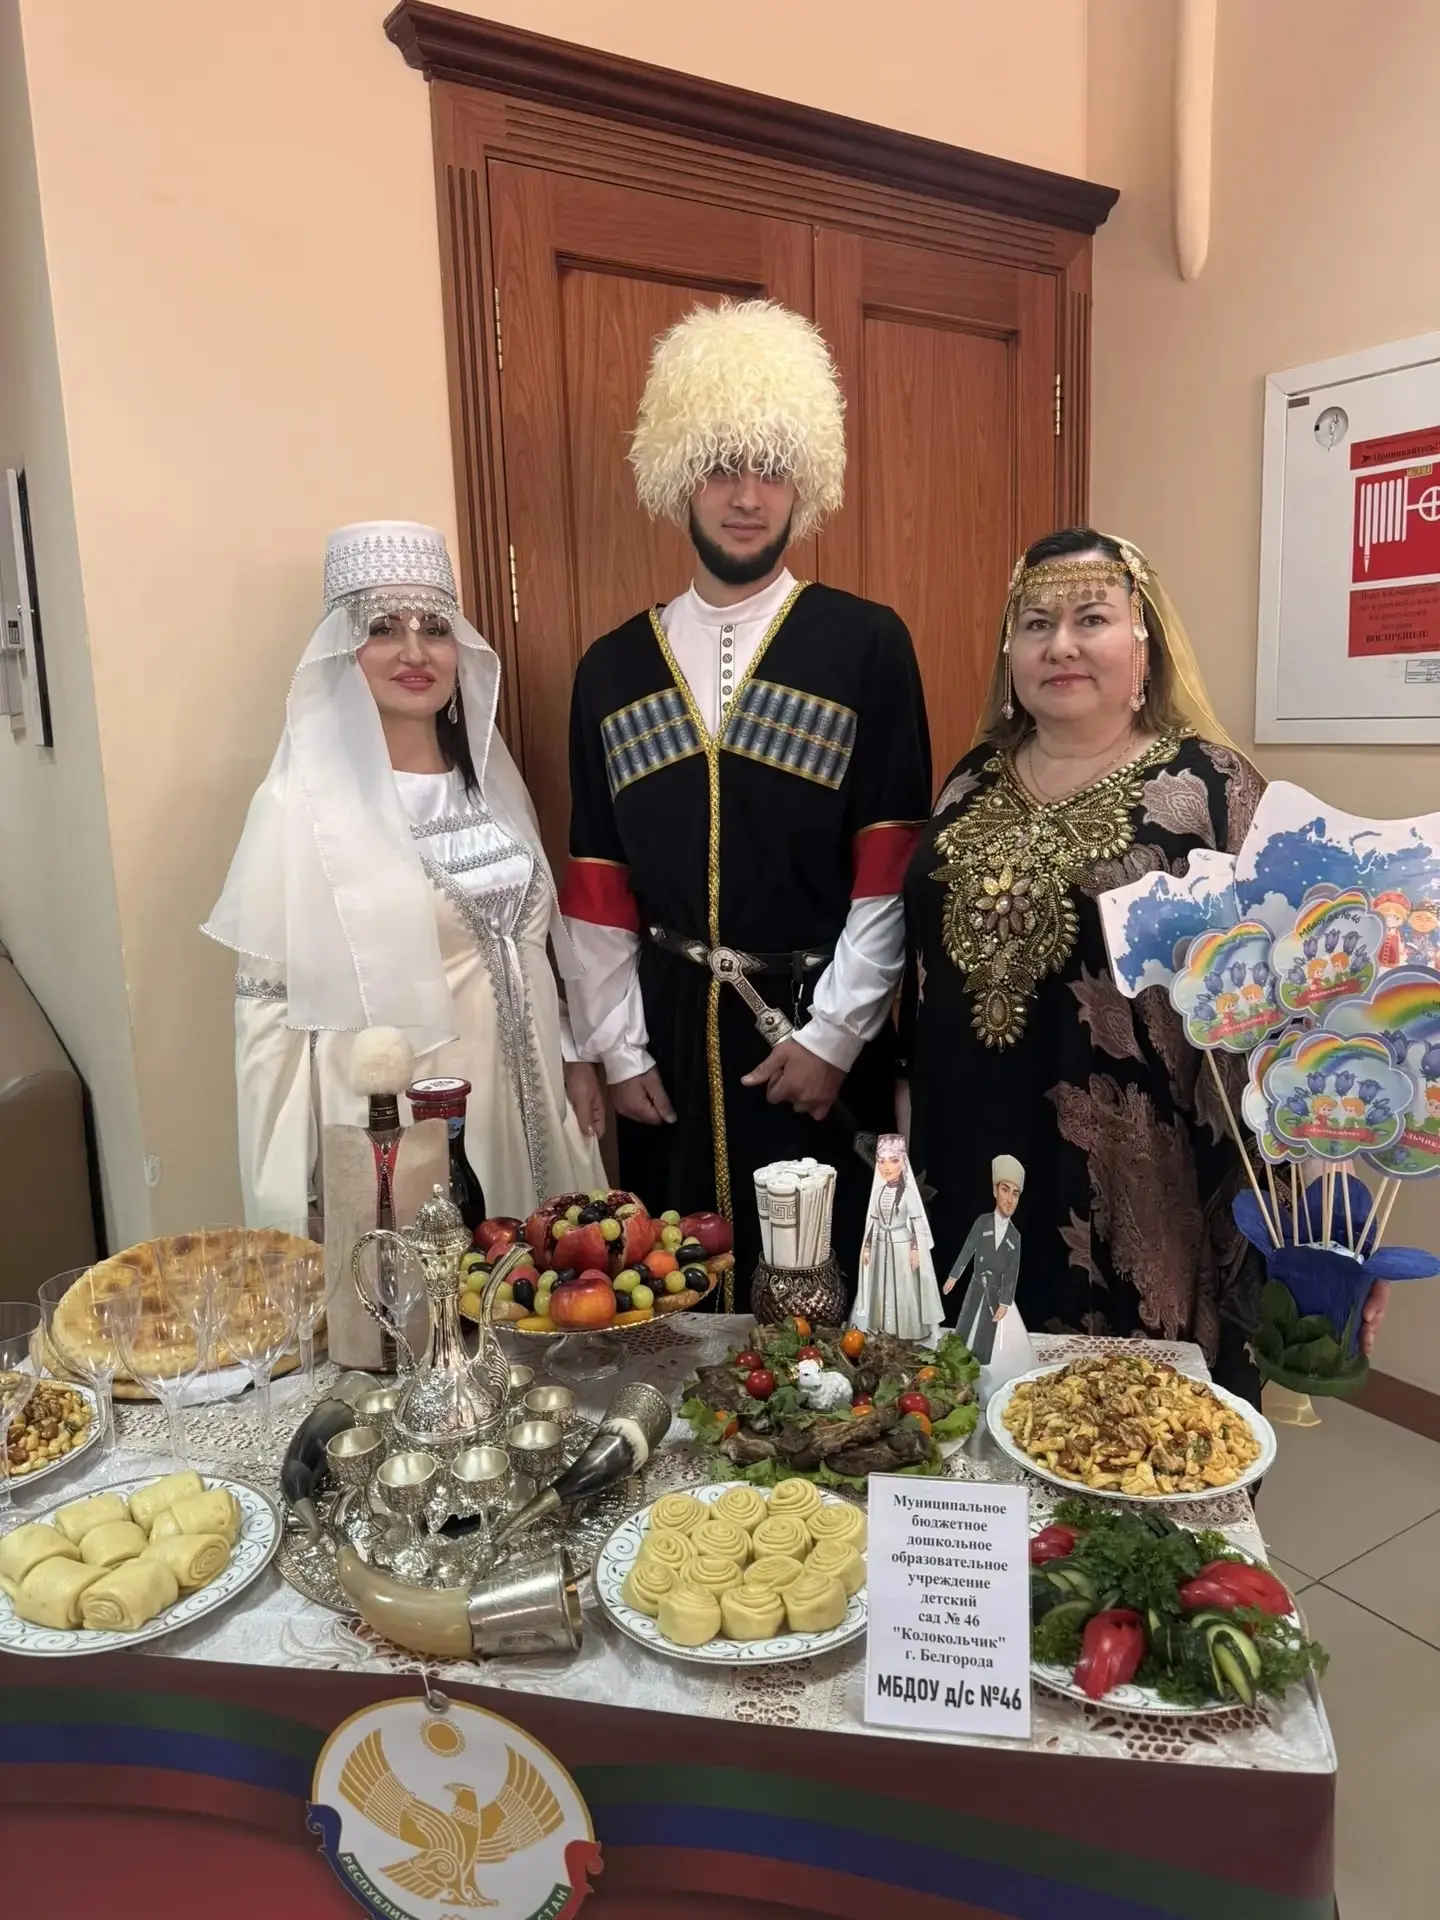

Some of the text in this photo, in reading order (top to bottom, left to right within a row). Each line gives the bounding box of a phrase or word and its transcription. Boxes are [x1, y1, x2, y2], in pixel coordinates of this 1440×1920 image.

[893, 1494, 1007, 1515] Муниципальное
[912, 1514, 988, 1532] бюджетное
[907, 1535, 993, 1551] дошкольное
[891, 1551, 1008, 1572] образовательное
[908, 1573, 991, 1589] учреждение
[920, 1592, 977, 1608] детский
[918, 1612, 980, 1627] сад № 46
[893, 1626, 1006, 1649] "Колокольчик"
[905, 1648, 994, 1669] г. Белгорода
[877, 1673, 1022, 1711] МБДОУ д/с №46
